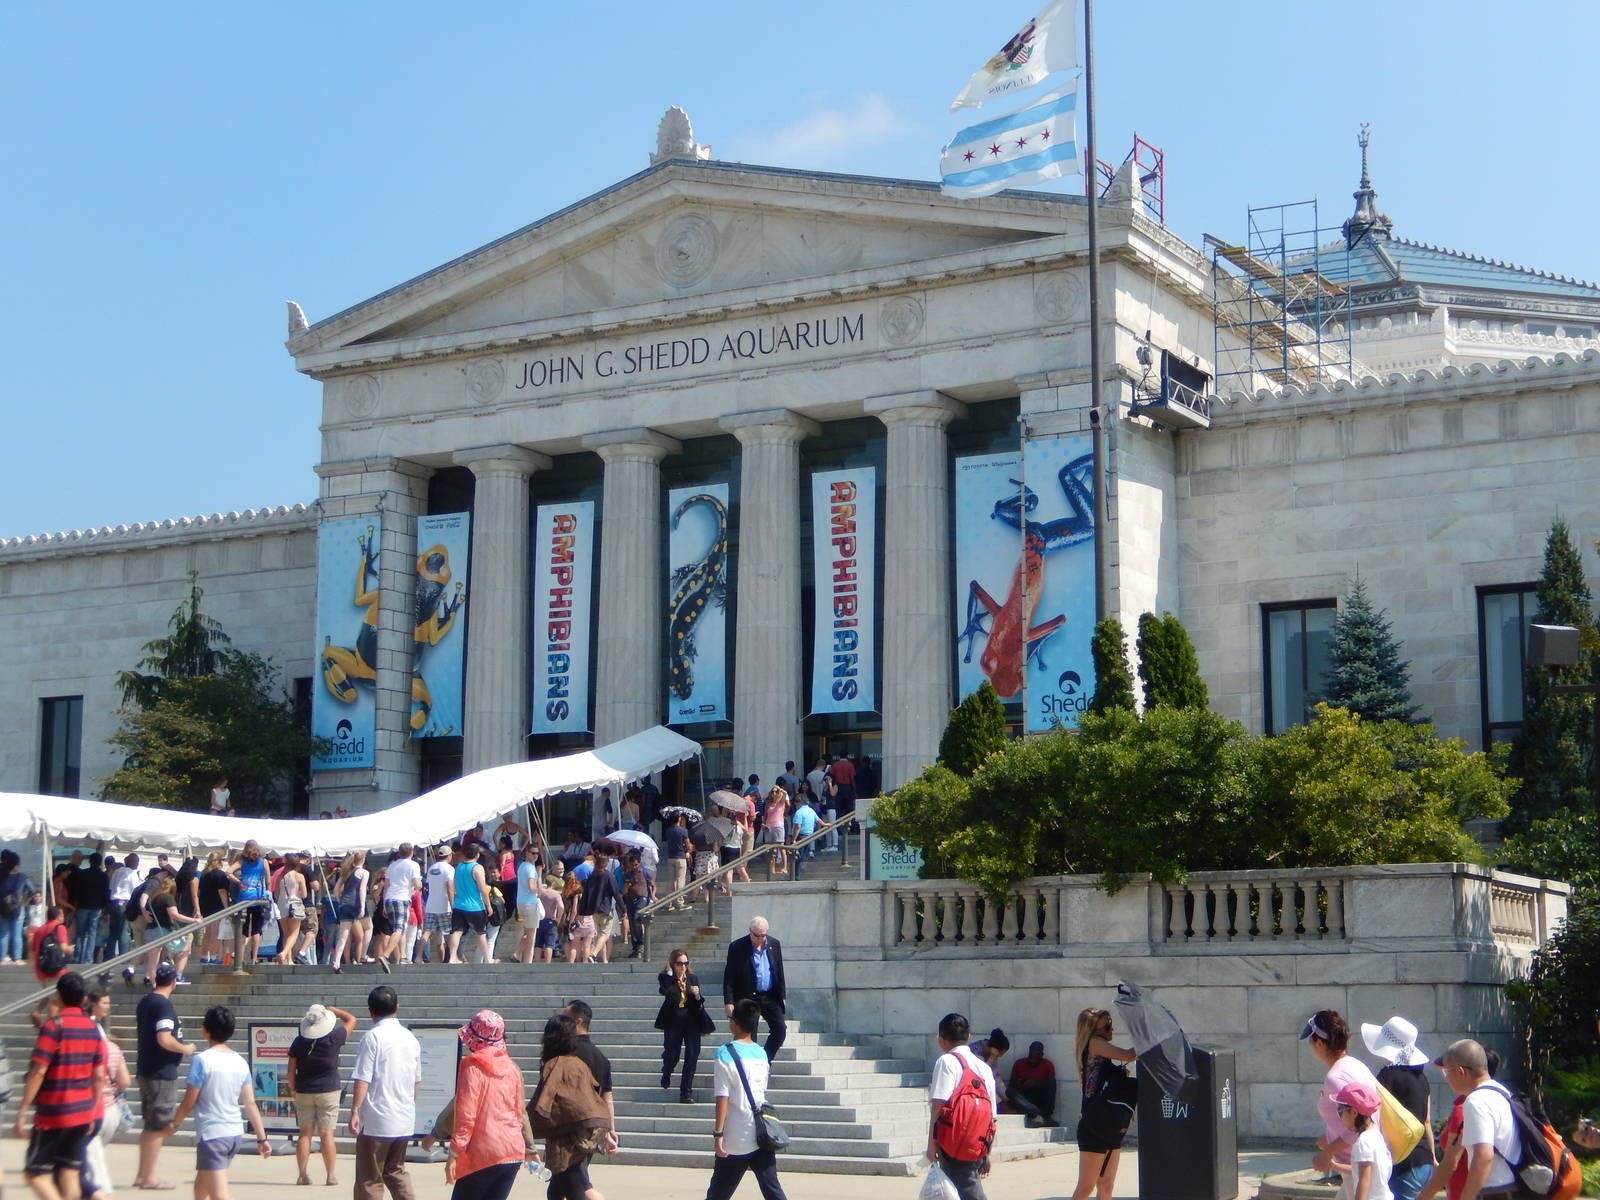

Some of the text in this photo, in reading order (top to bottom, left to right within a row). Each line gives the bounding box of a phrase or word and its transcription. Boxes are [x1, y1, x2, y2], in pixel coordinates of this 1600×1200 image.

[515, 313, 865, 390] JOHN G. SHEDD AQUARIUM
[545, 513, 578, 722] AMPHIBIANS
[830, 480, 859, 701] AMPHIBIANS
[881, 851, 917, 865] Shedd
